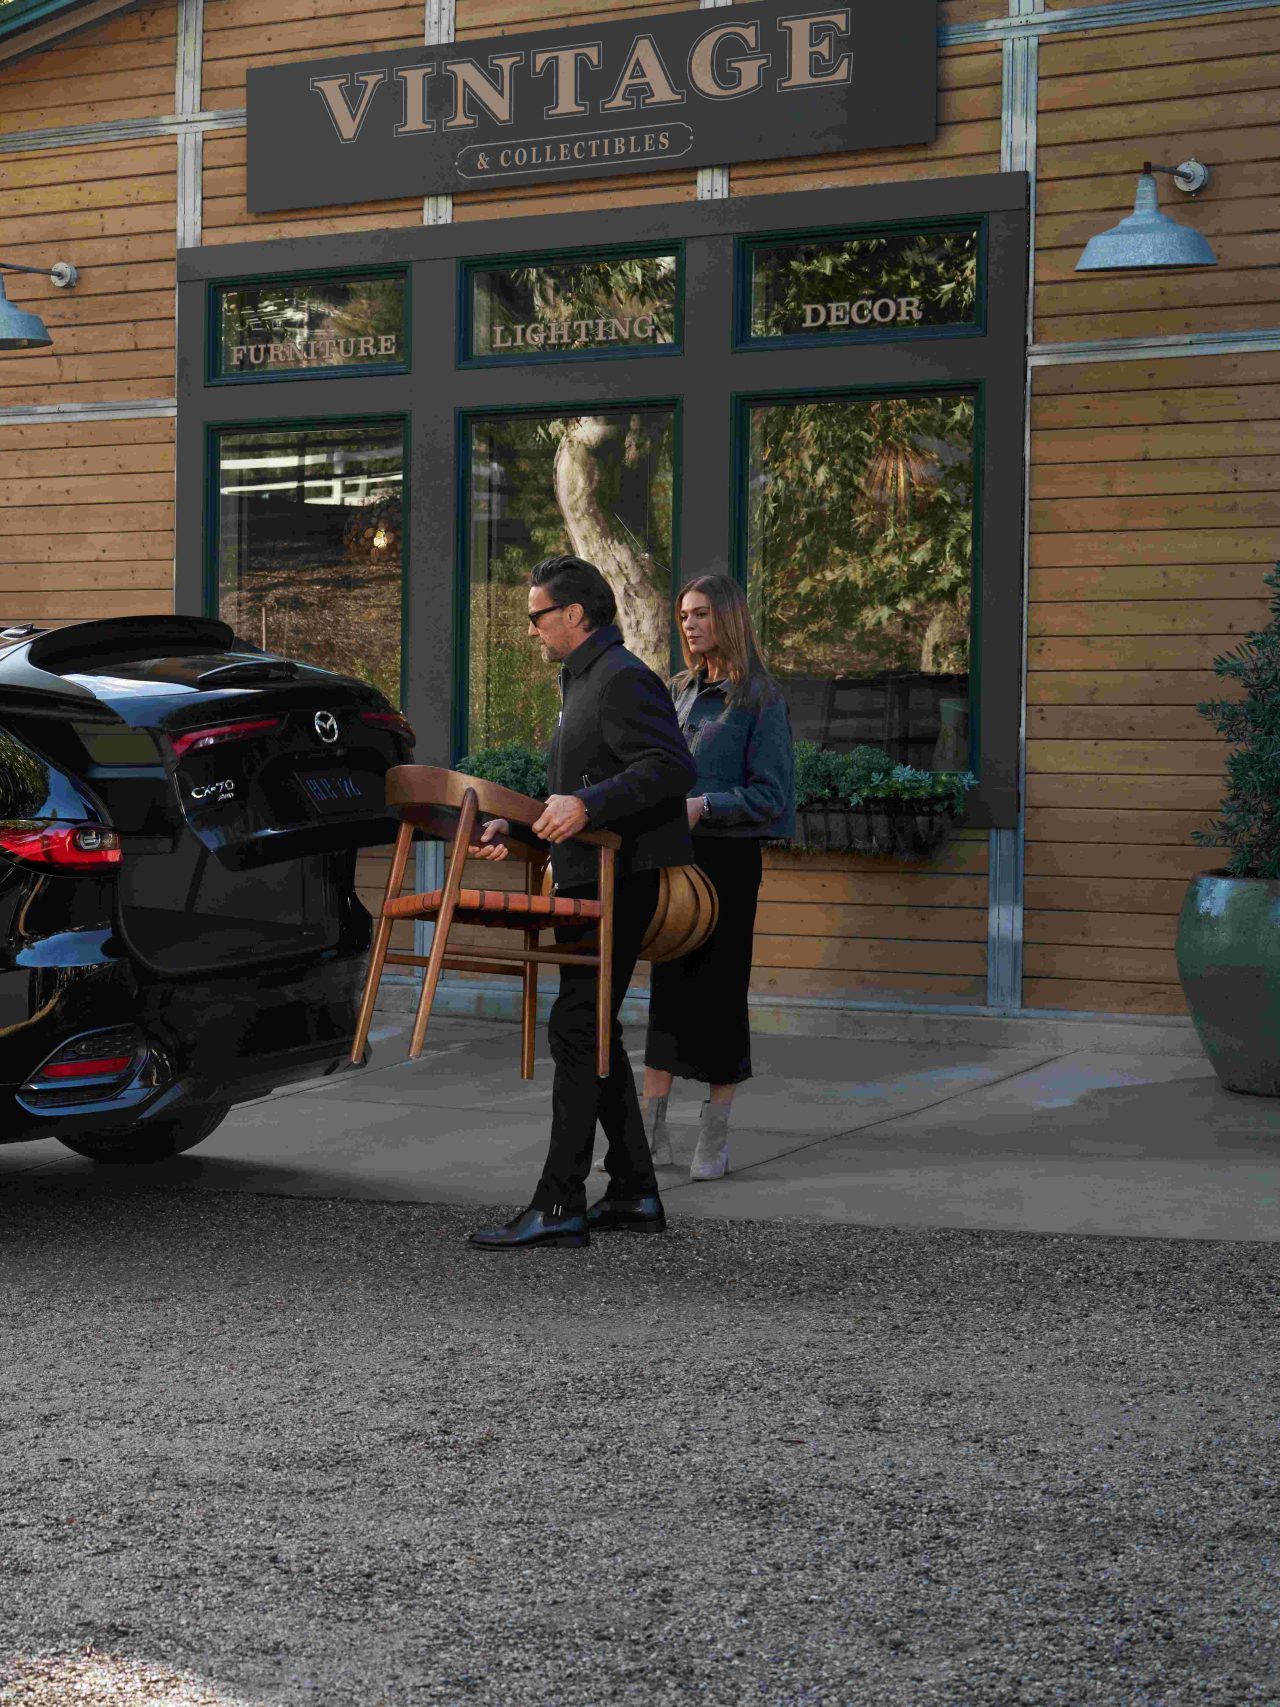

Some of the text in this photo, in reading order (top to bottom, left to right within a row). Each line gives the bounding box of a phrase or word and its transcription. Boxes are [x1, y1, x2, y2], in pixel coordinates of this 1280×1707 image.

[311, 9, 852, 141] VINTAGE
[477, 132, 671, 170] & COLLECTIBLES
[802, 297, 923, 328] DECOR
[492, 315, 656, 348] LIGHTING
[231, 335, 397, 365] FURNITURE
[191, 779, 235, 799] CX-70
